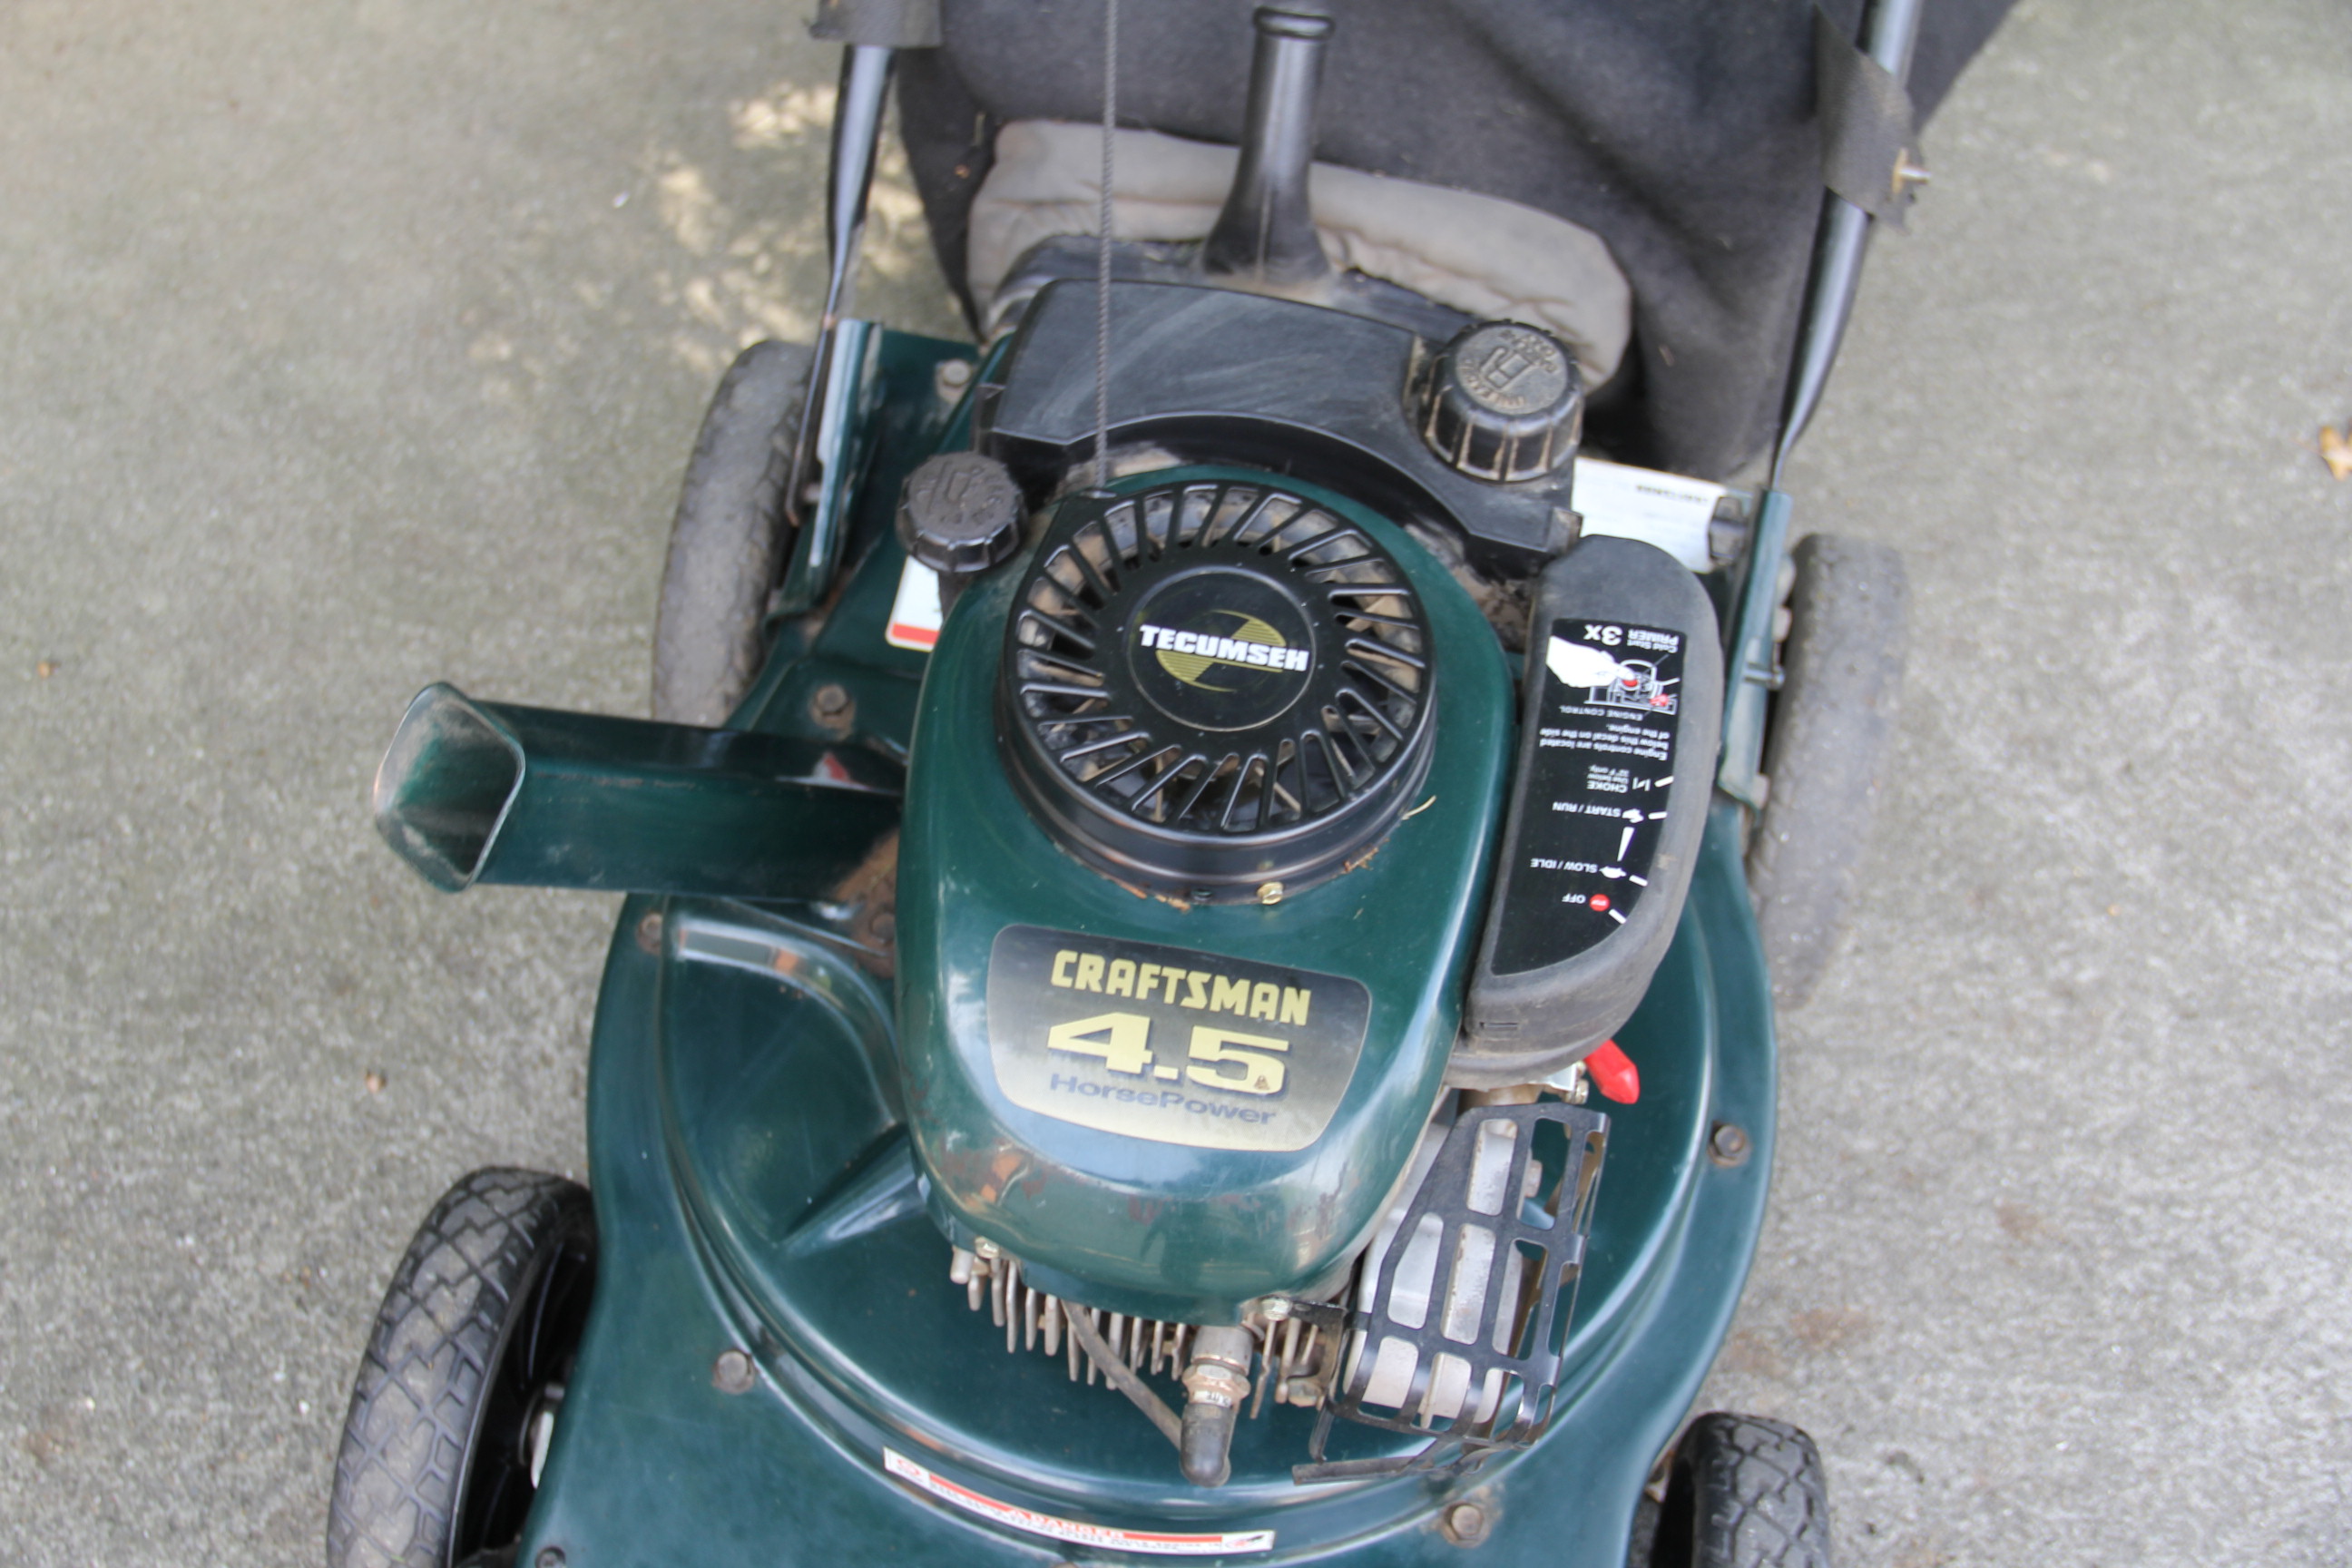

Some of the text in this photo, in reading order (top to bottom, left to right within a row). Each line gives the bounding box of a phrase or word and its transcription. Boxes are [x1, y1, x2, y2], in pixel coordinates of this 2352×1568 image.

[1628, 629, 1680, 646] PRIMER
[1140, 624, 1309, 671] TECUMSEH
[1627, 639, 1679, 653] Cold Start
[1559, 705, 1644, 721] ENGINE CONTROL
[1539, 728, 1670, 750] below this decal on the side
[1642, 728, 1658, 738] the
[1657, 731, 1671, 740] of
[1539, 738, 1668, 761] Engine controls are located
[1586, 780, 1628, 794] CHOKE
[1552, 801, 1577, 812] RUN
[1584, 805, 1622, 818] START
[1530, 858, 1557, 868] IDLE
[1563, 860, 1598, 874] SLOW
[1562, 893, 1586, 904] OFF
[1051, 949, 1311, 1026] CRAFTSMAN
[1046, 1012, 1289, 1096] 4.5
[1049, 1073, 1277, 1125] HorsePower
